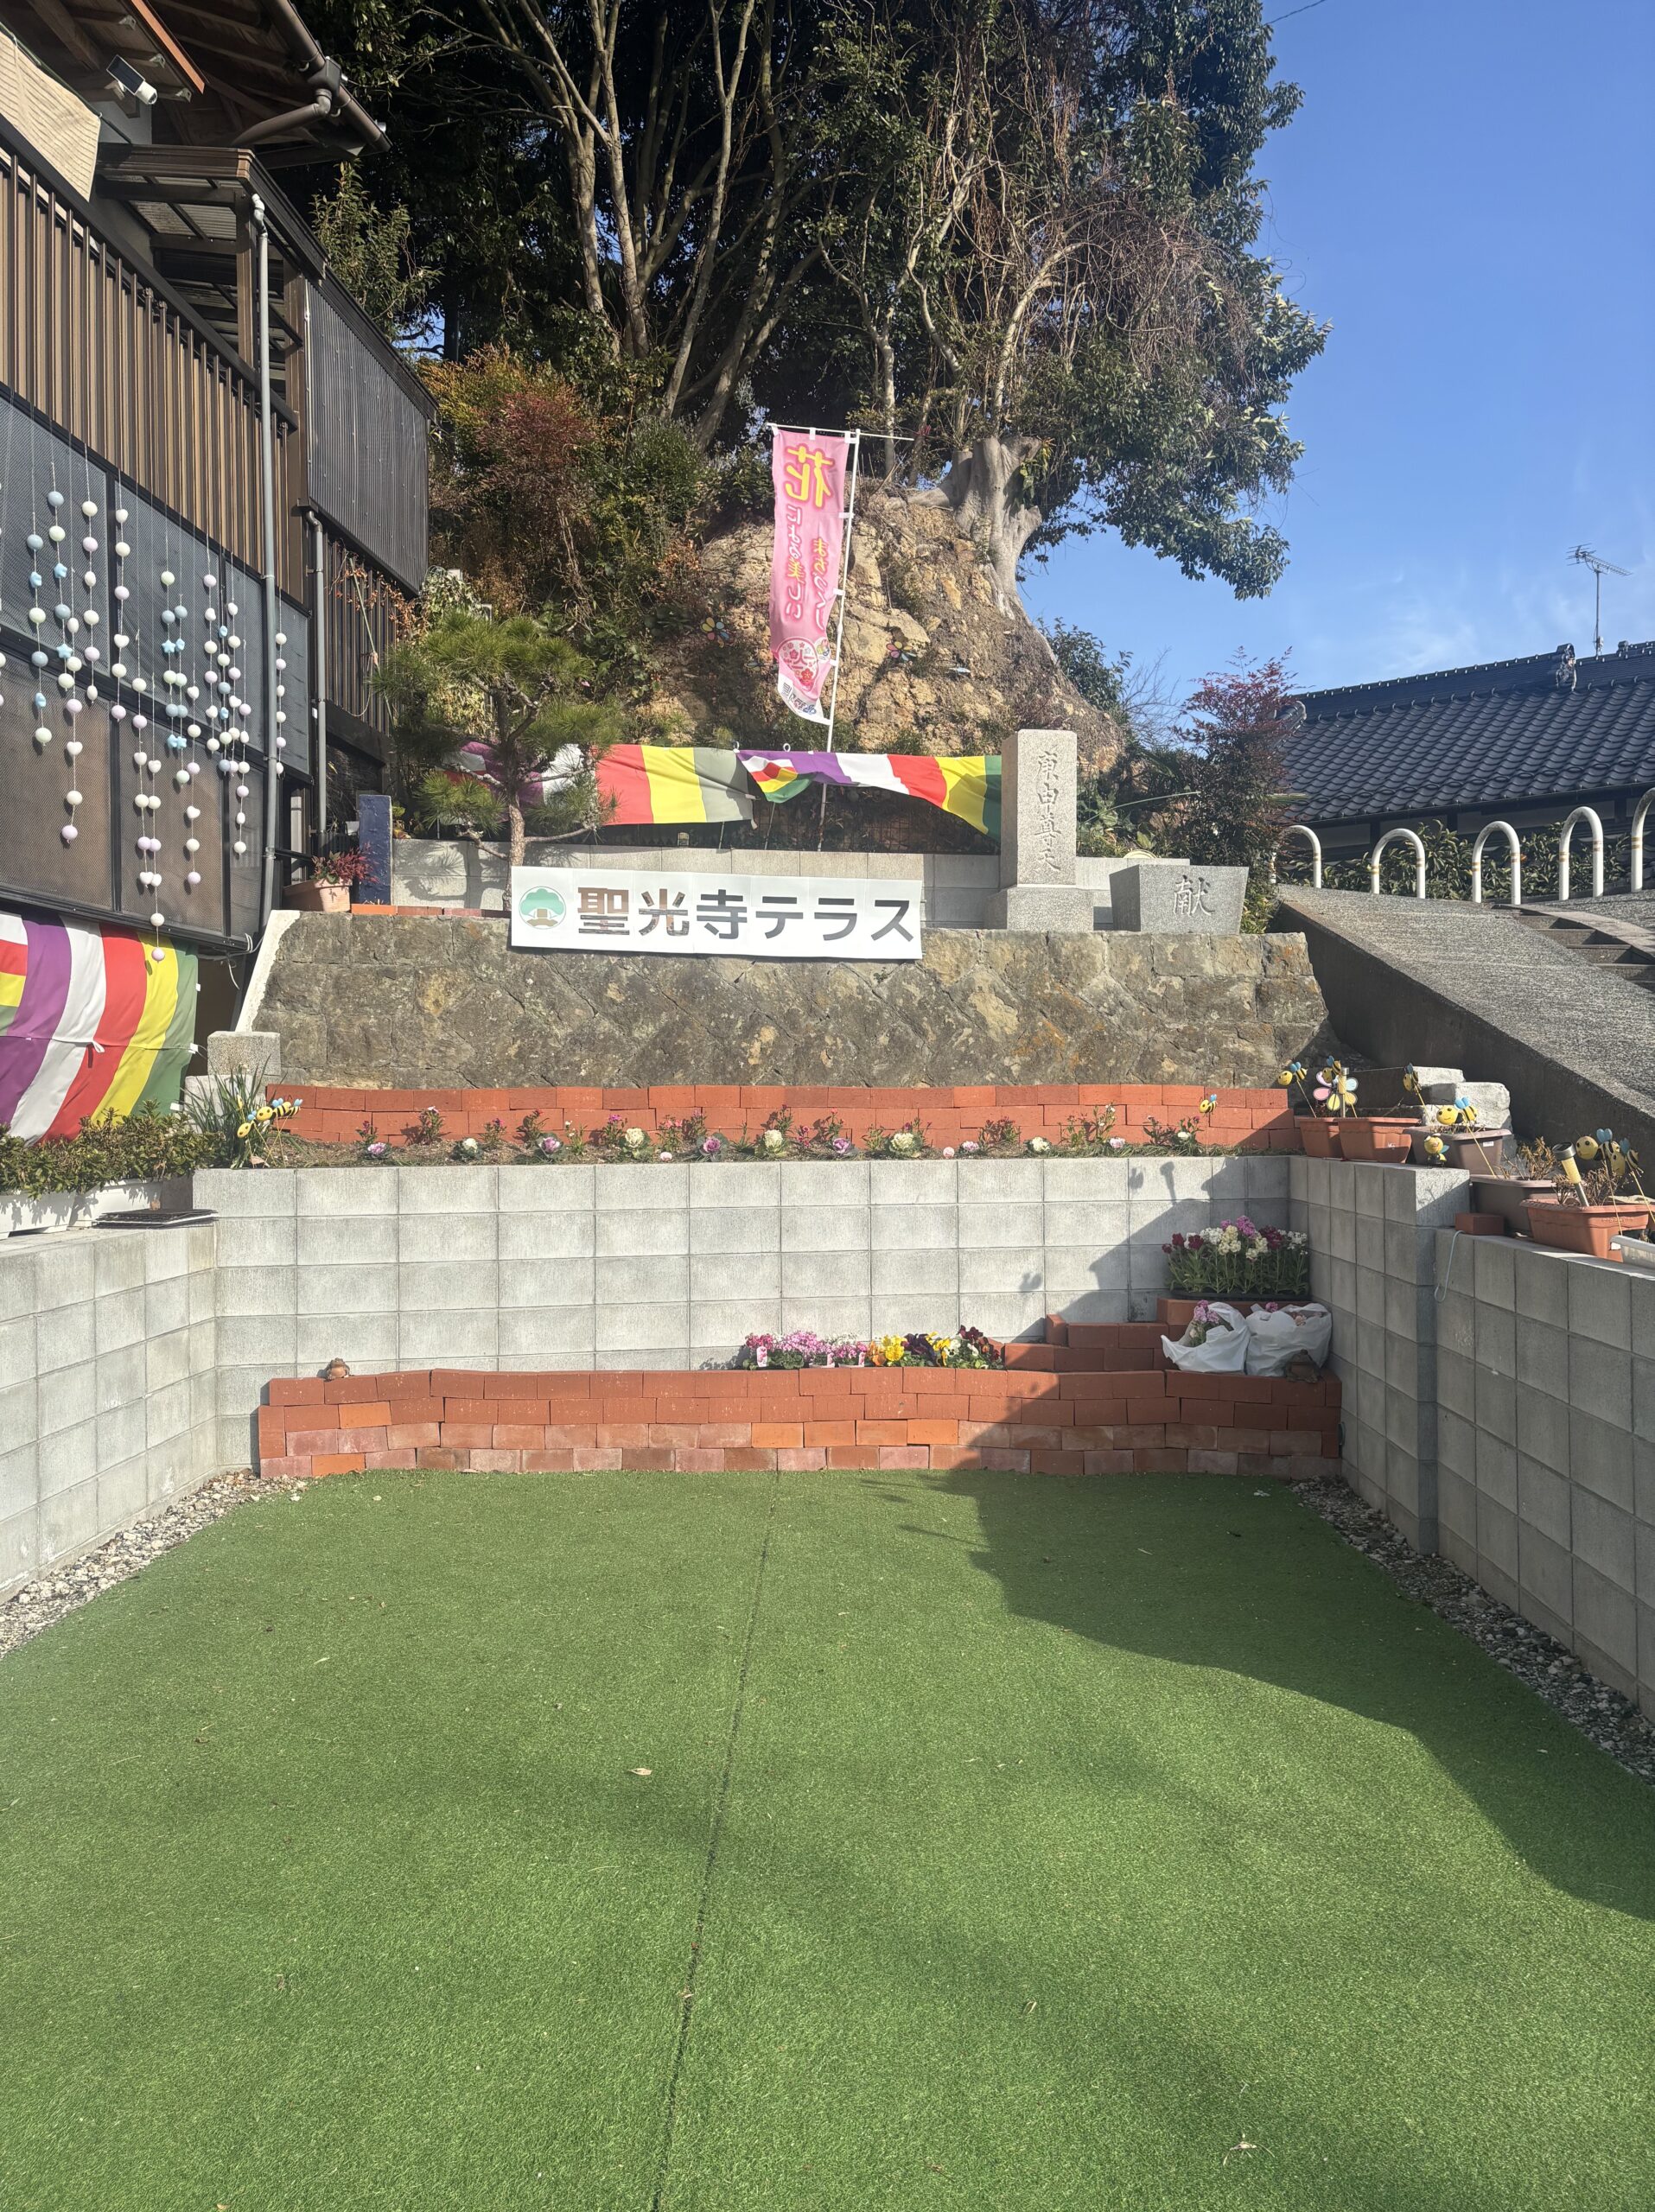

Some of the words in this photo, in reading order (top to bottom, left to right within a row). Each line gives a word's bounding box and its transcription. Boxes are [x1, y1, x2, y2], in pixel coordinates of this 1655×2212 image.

[1034, 750, 1061, 871] 庚申尊天
[577, 887, 914, 943] 聖光寺テラス
[1173, 874, 1214, 916] 献
